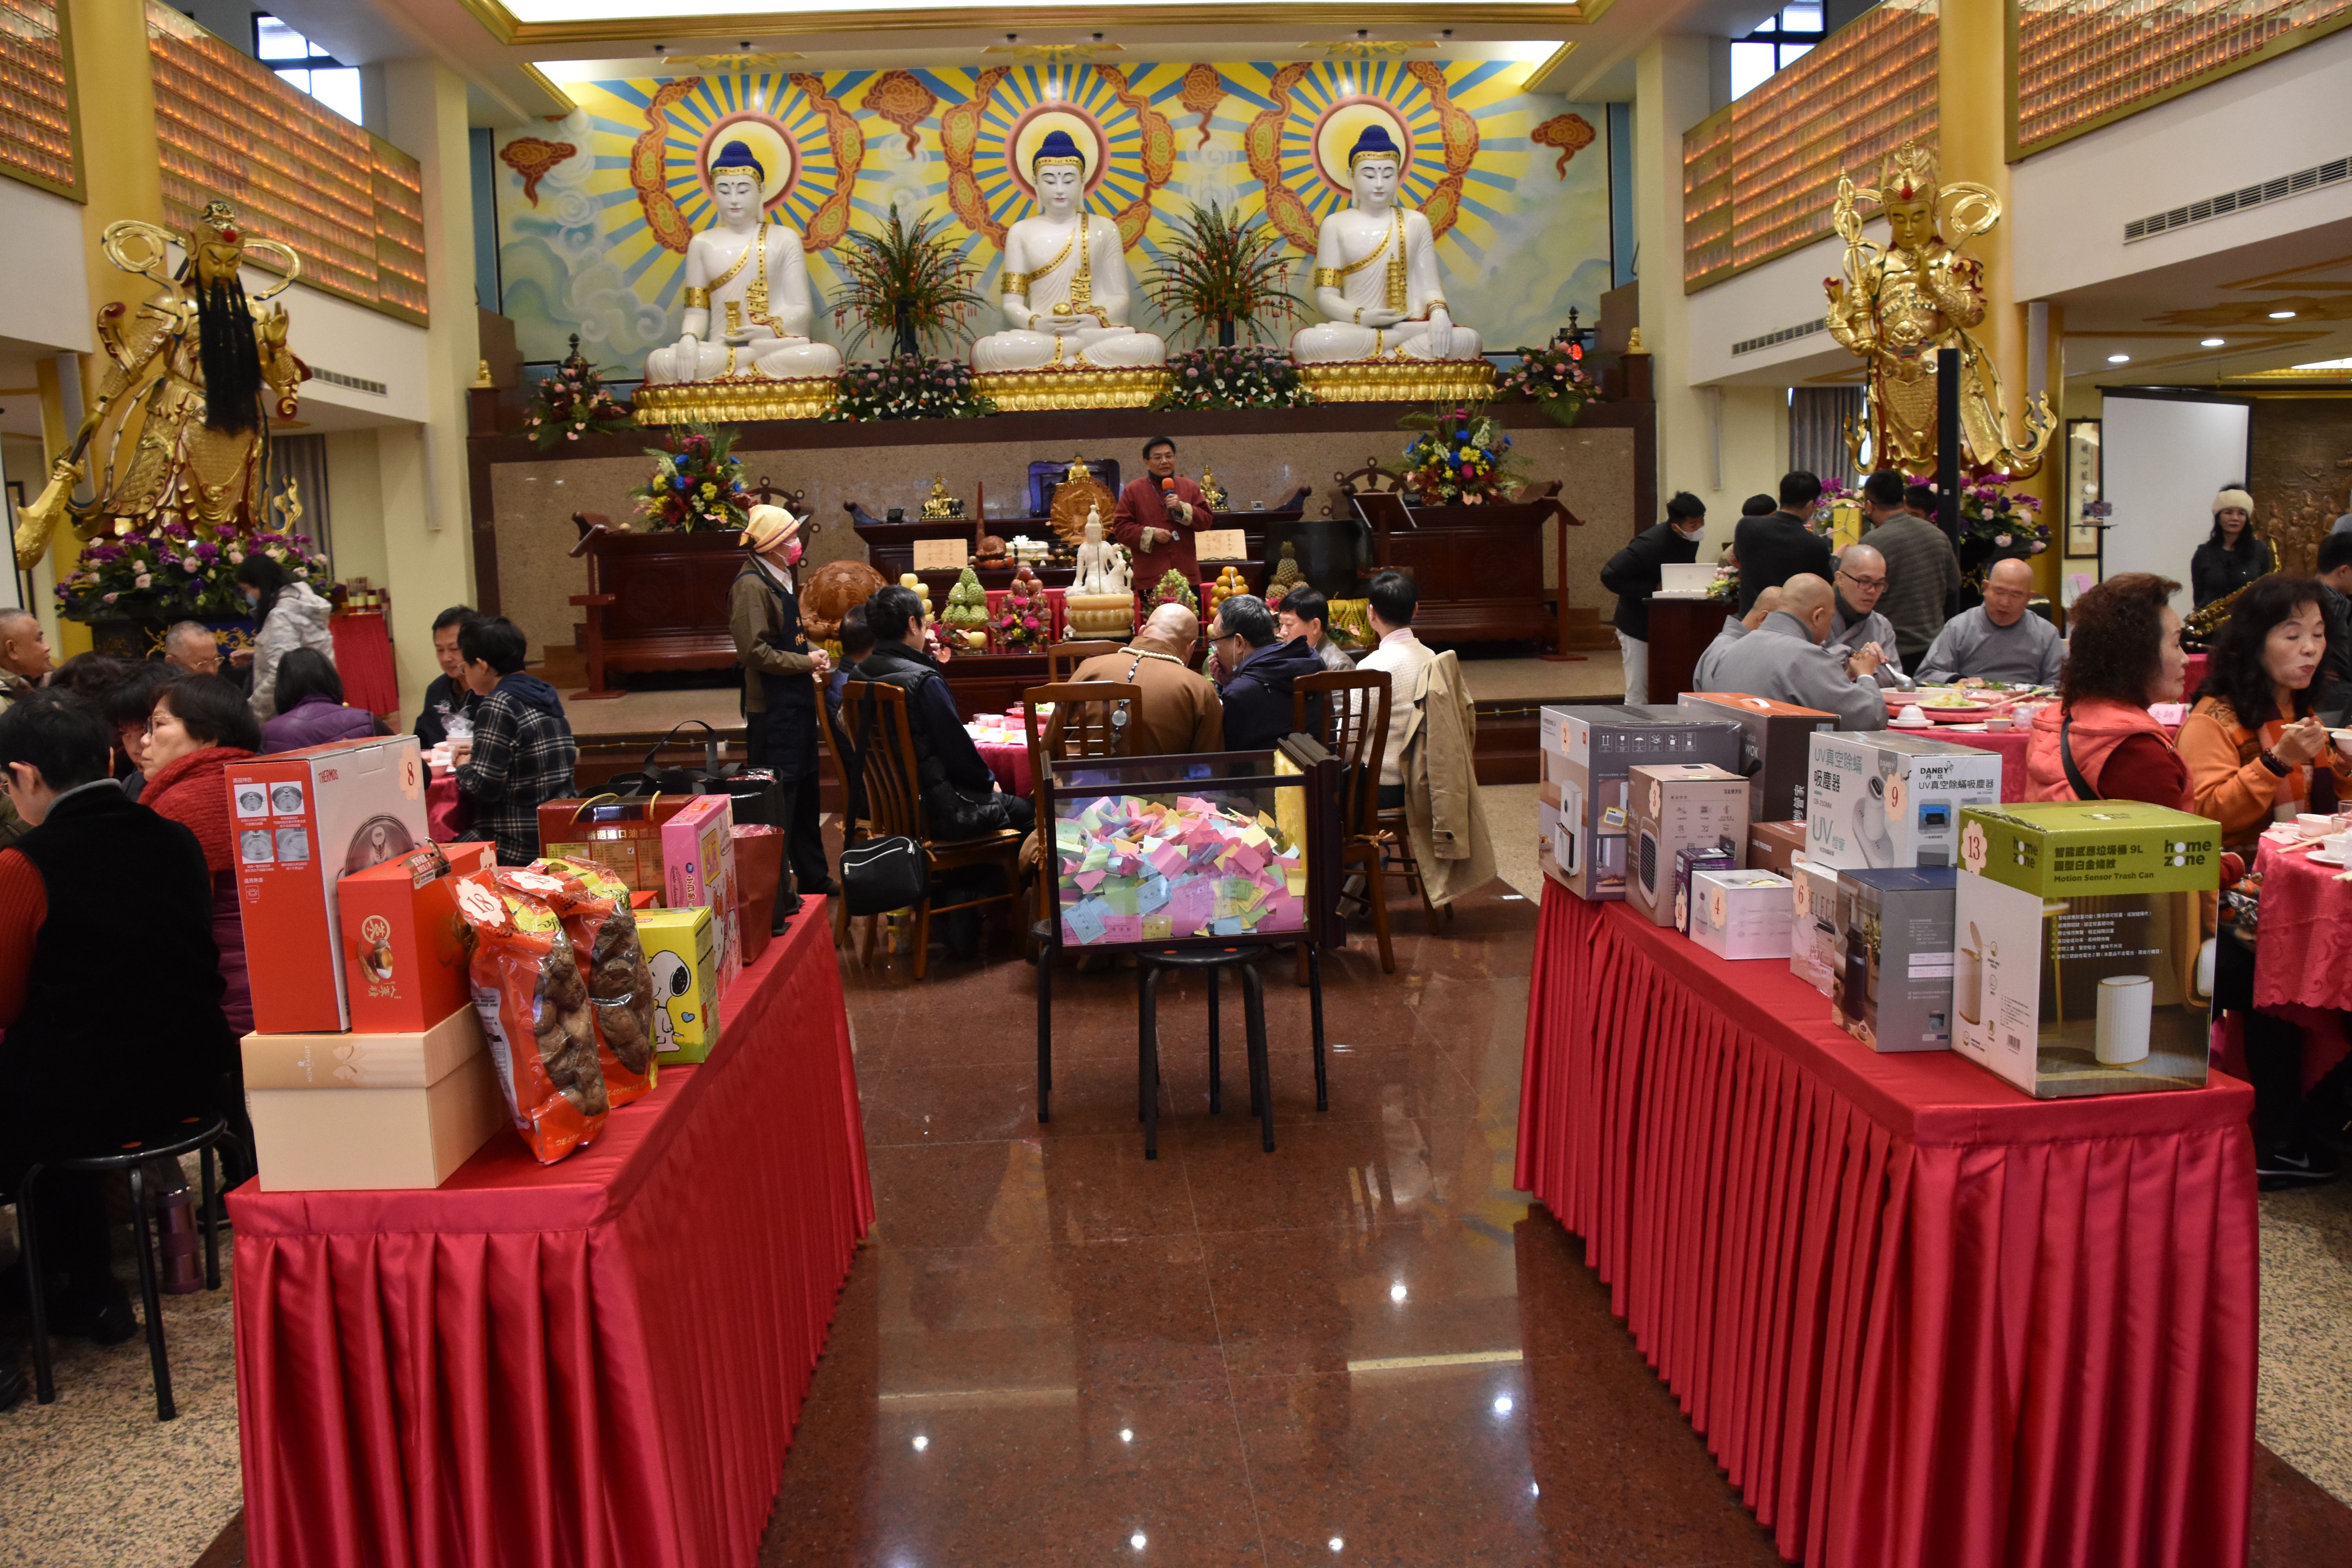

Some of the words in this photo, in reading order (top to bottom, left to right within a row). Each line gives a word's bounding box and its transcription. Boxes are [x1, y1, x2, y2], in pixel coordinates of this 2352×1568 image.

[1563, 728, 1566, 744] 2
[1745, 743, 1759, 758] WOK
[318, 769, 338, 784] THERMOS
[407, 761, 414, 786] 8
[1814, 769, 1840, 793] 吸塵器
[1652, 789, 1657, 807] 3
[1891, 786, 1898, 808] 9
[1812, 814, 1834, 845] UV
[1968, 835, 1980, 860] 13
[2013, 835, 2038, 856] home
[2055, 844, 2127, 858] 智能感應垃圾桶
[2130, 845, 2143, 854] 9L
[2164, 839, 2212, 853] home
[2013, 852, 2035, 869] zone
[2054, 858, 2116, 871] 圓型白金條紋
[2164, 854, 2205, 867] zone
[524, 875, 550, 885] 19
[2054, 874, 2082, 883] Motion
[2084, 873, 2112, 882] Sensor
[1798, 884, 1804, 904] 6
[466, 893, 495, 913] 18
[1715, 896, 1720, 915] 4
